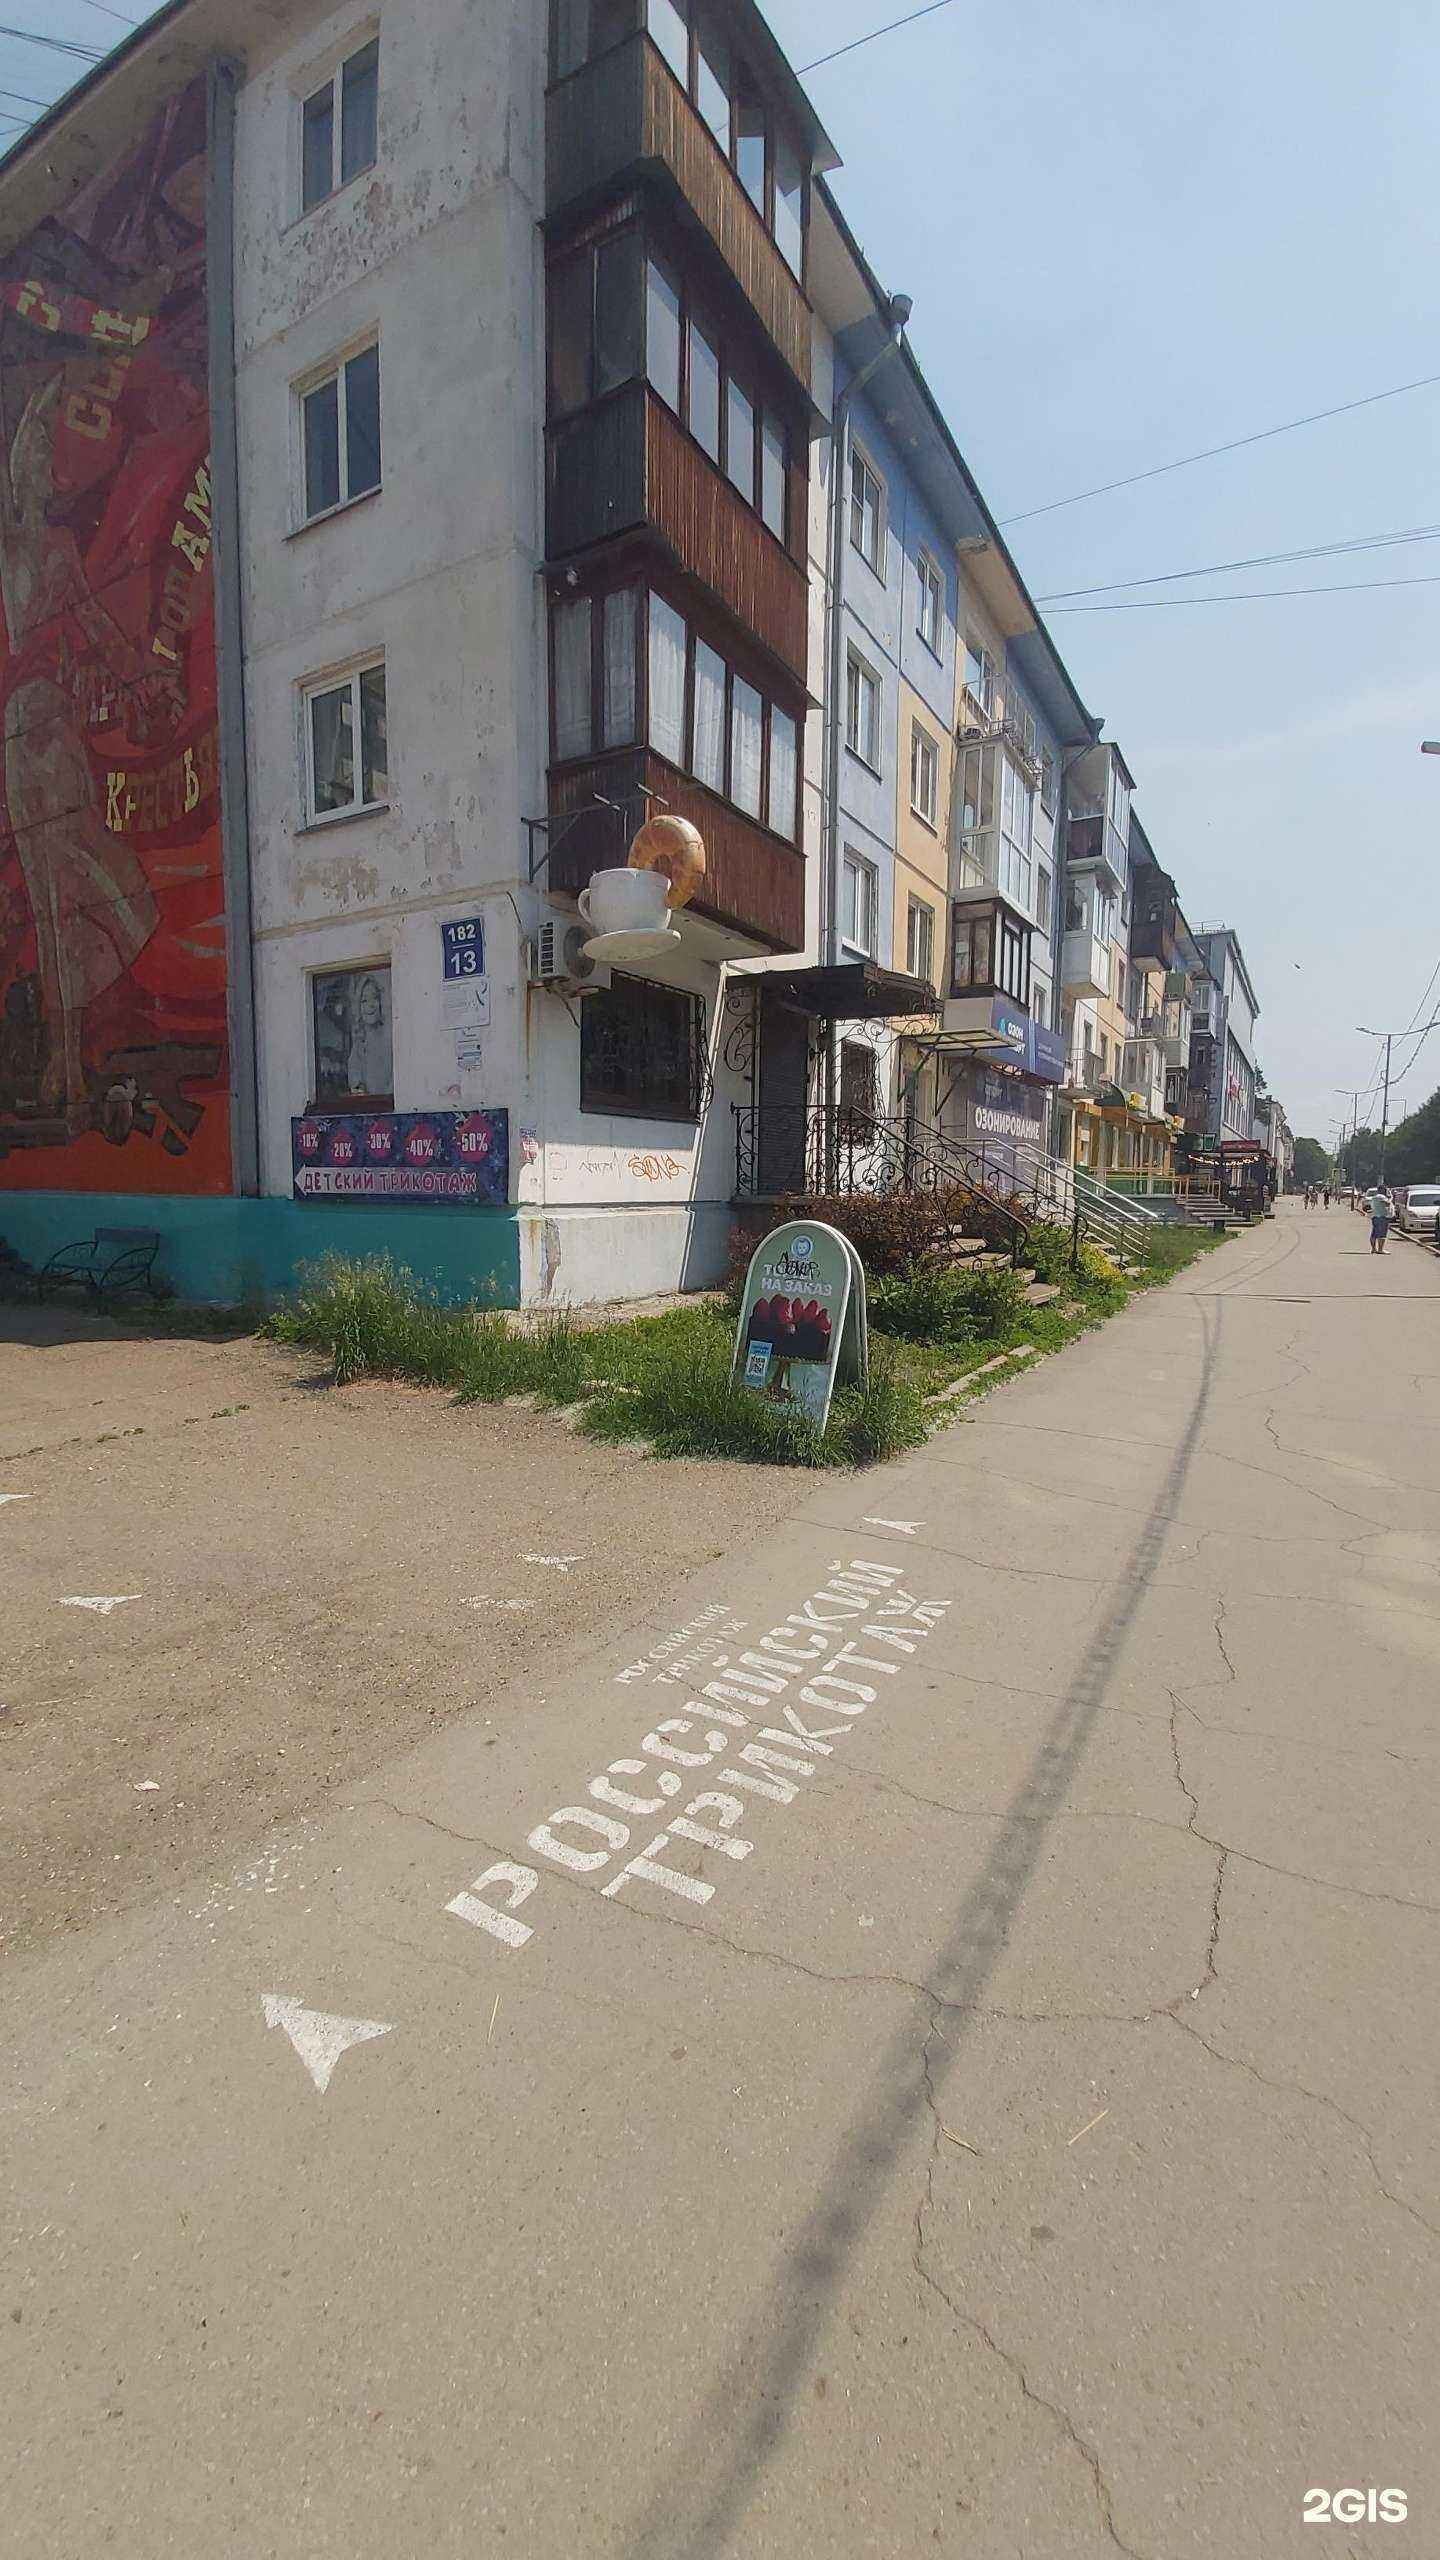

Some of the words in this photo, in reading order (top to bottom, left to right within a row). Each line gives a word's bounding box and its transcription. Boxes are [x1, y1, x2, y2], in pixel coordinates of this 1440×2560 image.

[448, 923, 477, 943] 182
[450, 950, 477, 975] 13
[974, 1106, 1041, 1140] ОЗОНИРОВАНИЕ
[367, 1133, 391, 1150] -30%
[406, 1139, 434, 1157] -40%
[457, 1132, 489, 1153] -50%
[303, 1169, 375, 1191] ДЕТСКИЙ
[380, 1170, 478, 1193] ТРИКОТАЖ
[760, 1278, 783, 1291] НА
[784, 1280, 833, 1296] ЗАКАЗ
[444, 1559, 906, 1949] РОССИЙСКИЙ
[600, 1589, 953, 1906] ТРИКОТАЖ
